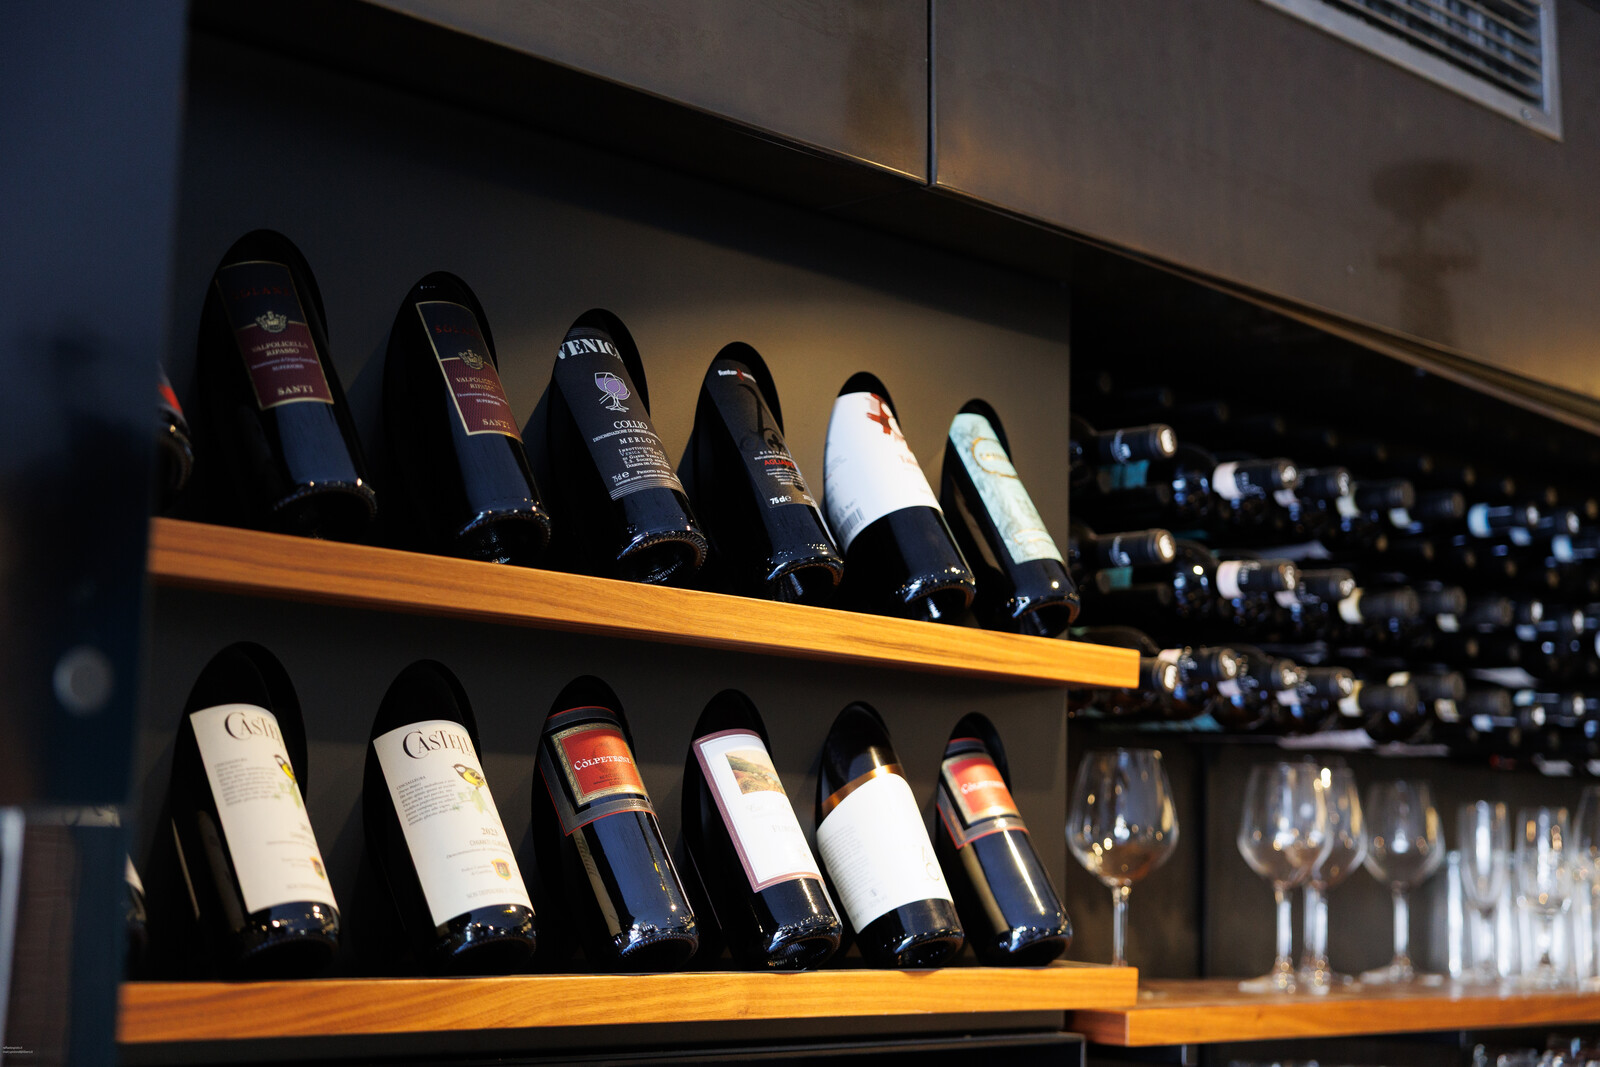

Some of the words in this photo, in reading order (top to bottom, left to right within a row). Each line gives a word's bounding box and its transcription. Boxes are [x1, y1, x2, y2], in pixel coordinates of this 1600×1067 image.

[277, 385, 314, 396] SANTI
[482, 418, 511, 430] SANTI
[613, 420, 648, 429] COLLIO
[619, 436, 657, 446] MERLOT
